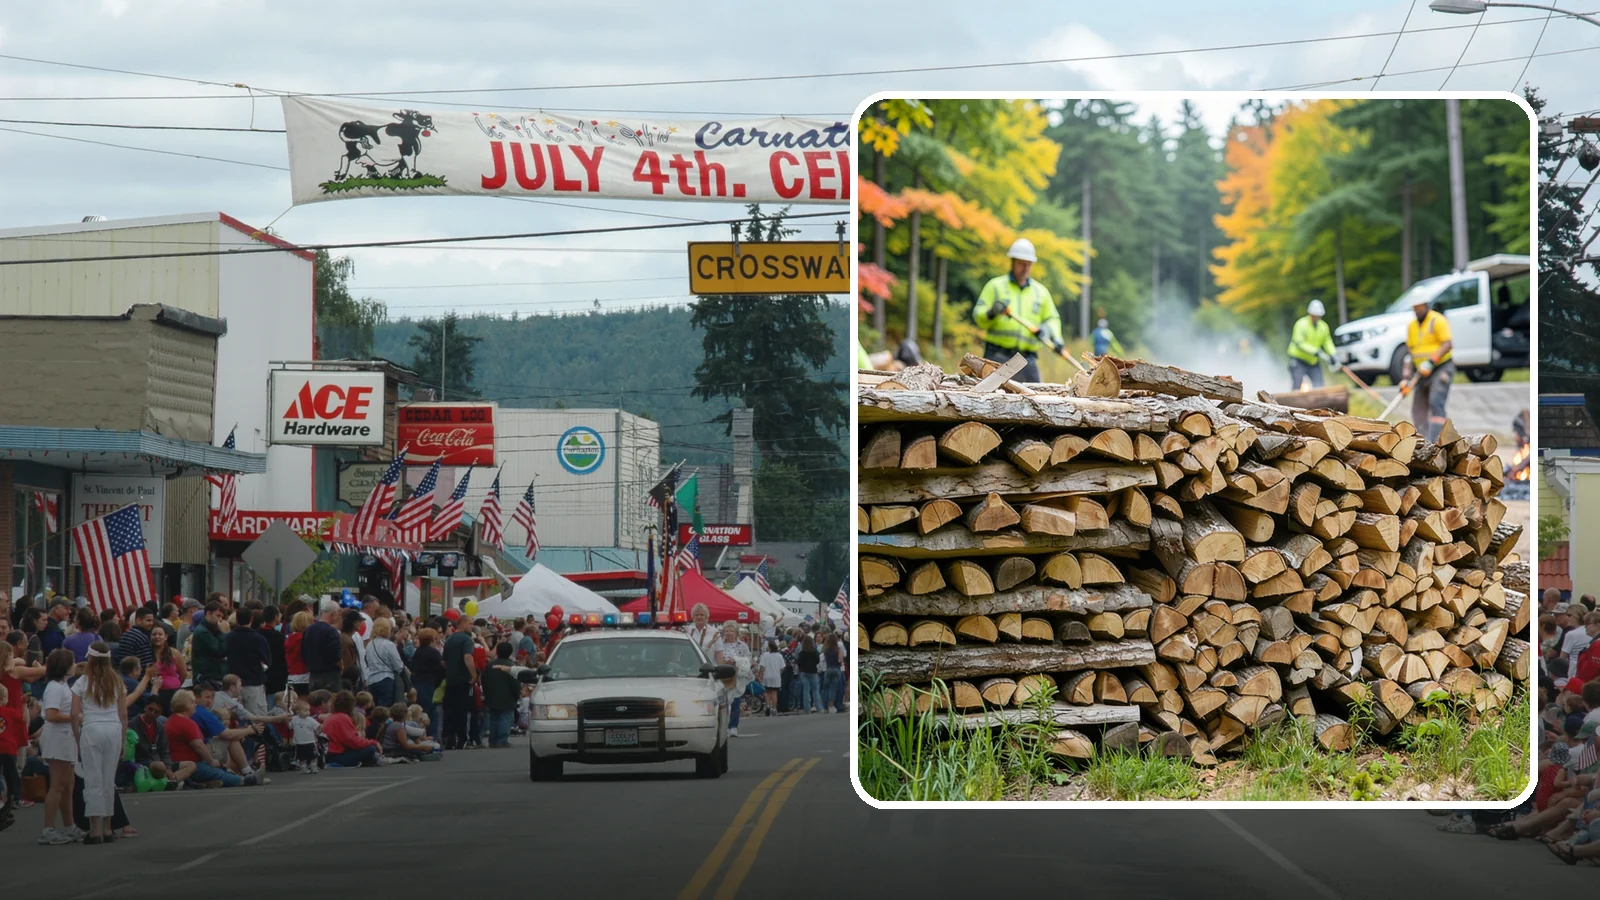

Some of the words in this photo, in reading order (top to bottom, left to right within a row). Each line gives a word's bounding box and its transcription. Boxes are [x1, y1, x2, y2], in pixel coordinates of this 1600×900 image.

[481, 140, 605, 192] JULY
[632, 149, 746, 198] 4th.
[697, 254, 850, 280] CROSSWA
[283, 380, 373, 420] ACE
[406, 409, 452, 422] CEDAR
[461, 409, 485, 422] LOG
[283, 421, 371, 437] Hardware
[416, 428, 477, 447] Coca-Cola
[83, 485, 93, 495] St.
[95, 485, 124, 495] Vincent
[126, 486, 136, 495] de
[137, 486, 155, 496] Paul
[213, 516, 330, 535] HARDARE
[688, 526, 741, 535] CRNATION
[699, 535, 730, 543] GLASS
